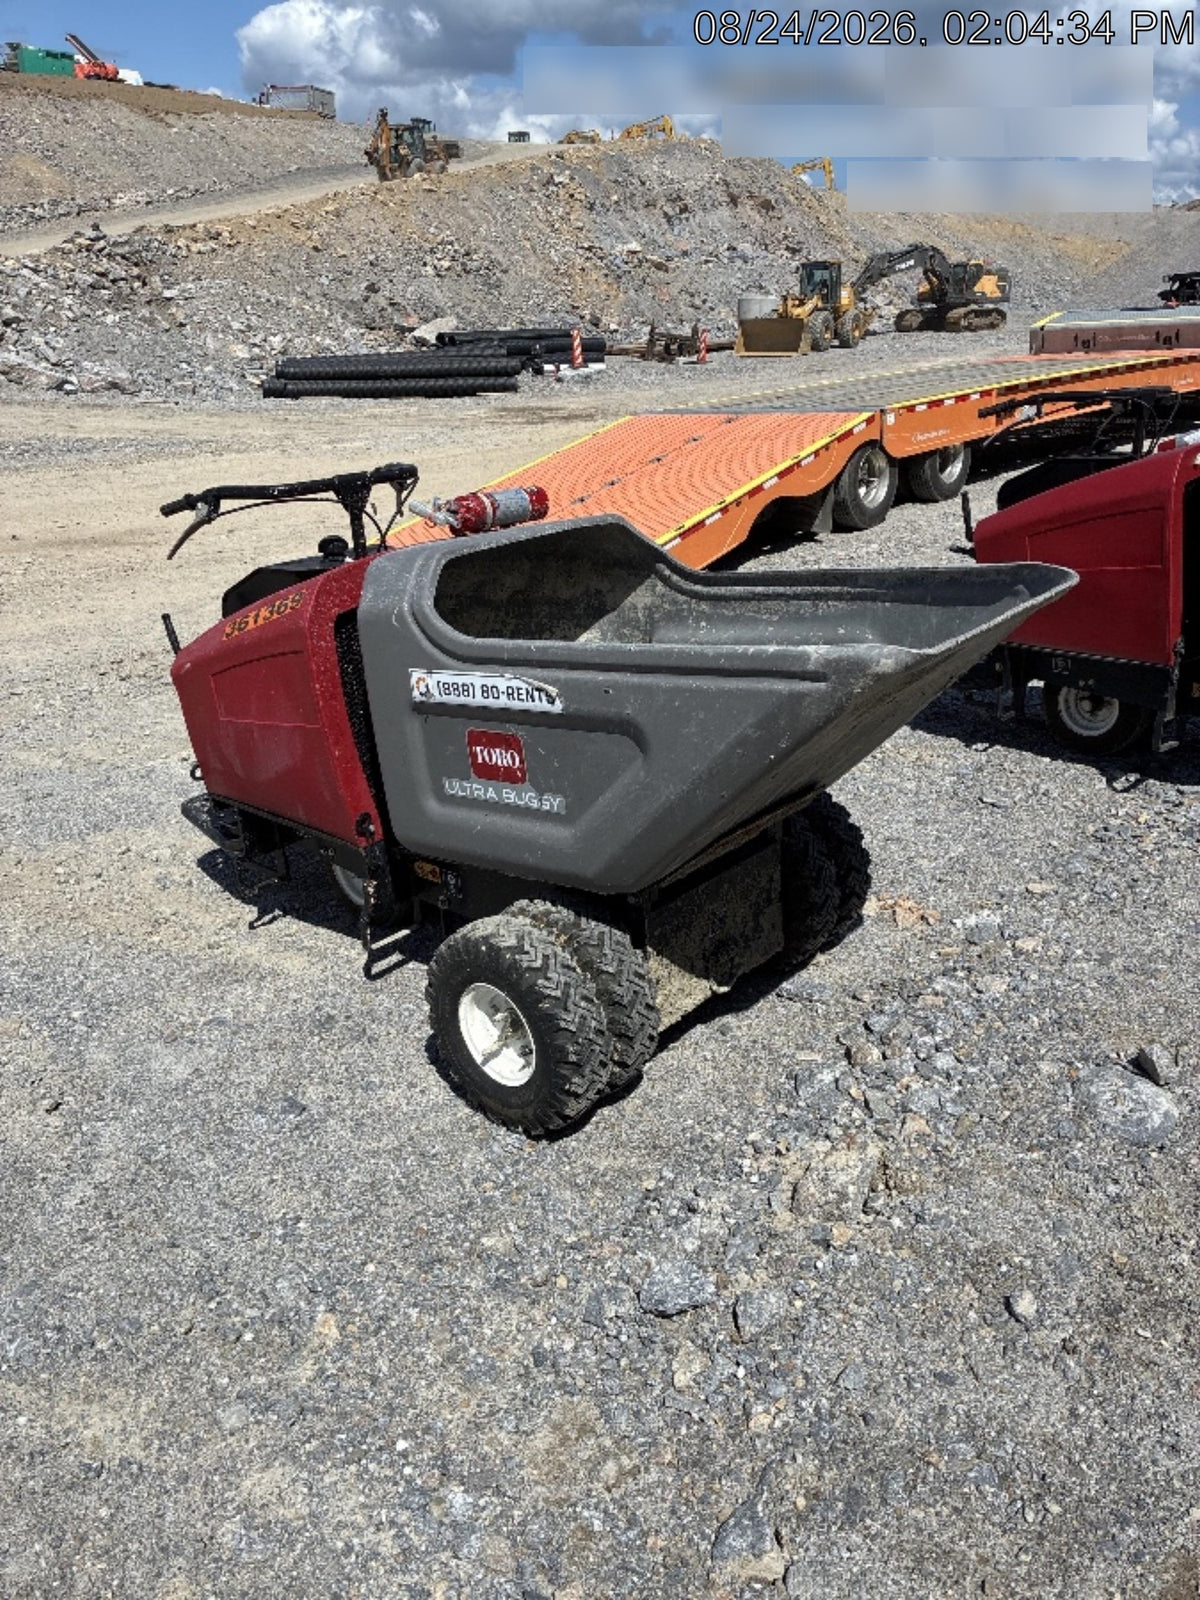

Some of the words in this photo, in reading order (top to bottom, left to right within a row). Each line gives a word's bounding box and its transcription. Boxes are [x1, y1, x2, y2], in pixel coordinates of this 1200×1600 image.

[436, 680, 476, 699] (888)
[472, 745, 521, 769] TORO
[444, 781, 499, 801] ULTRA
